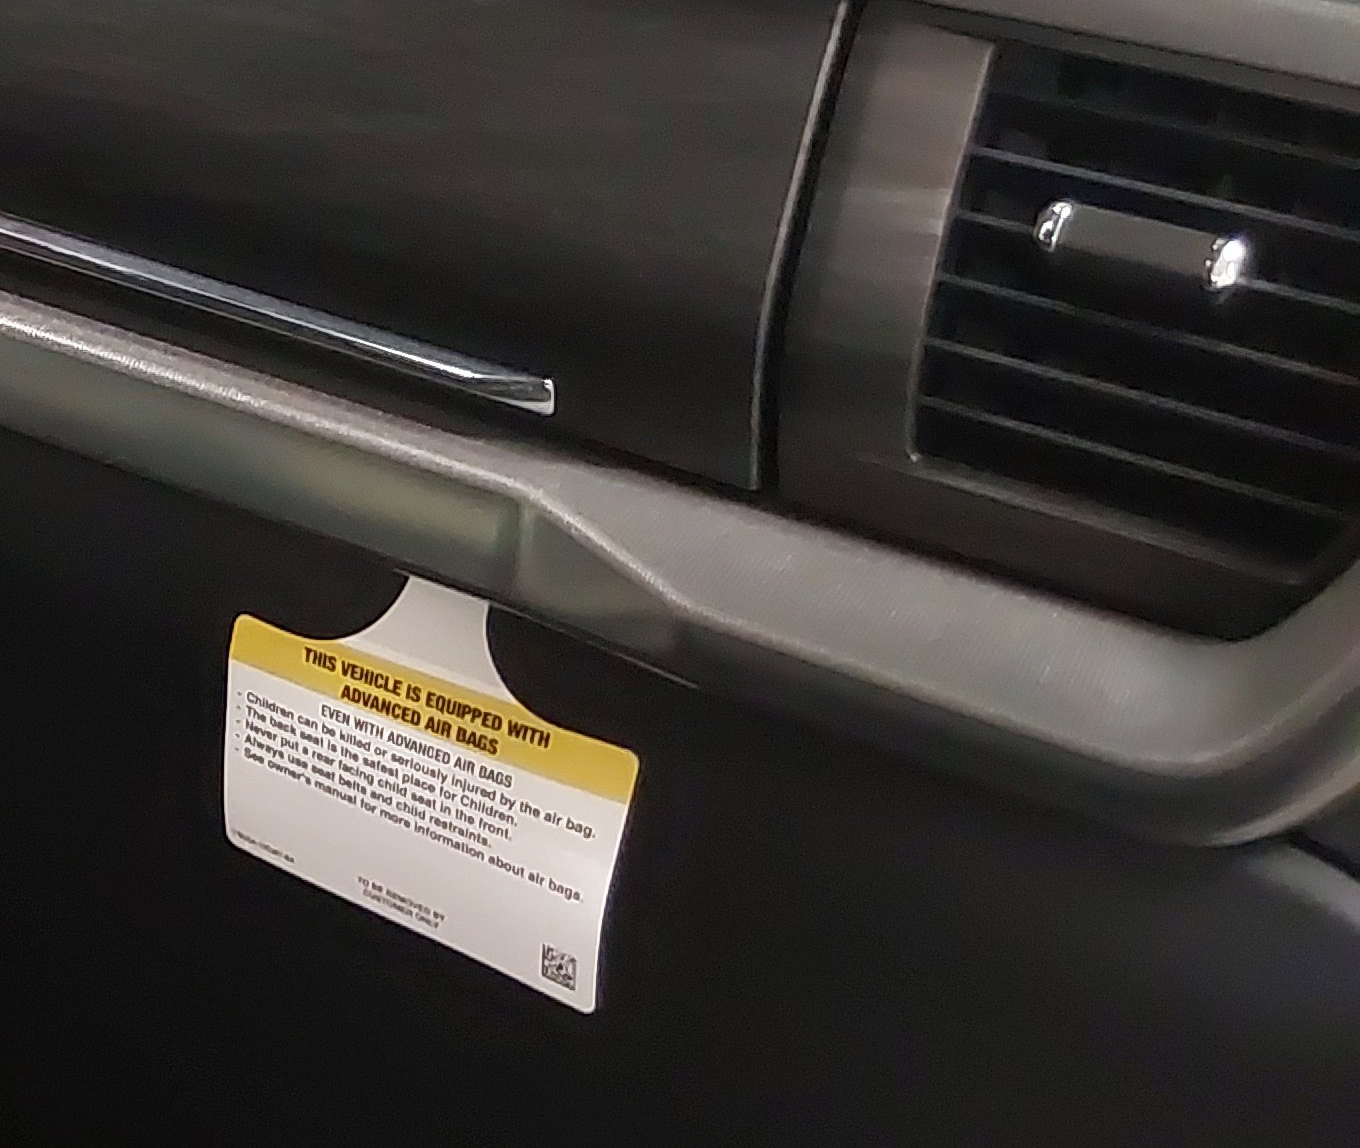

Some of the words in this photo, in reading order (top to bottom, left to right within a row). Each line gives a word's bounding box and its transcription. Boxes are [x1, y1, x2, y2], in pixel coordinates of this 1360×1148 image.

[304, 646, 337, 673] THIS
[341, 660, 403, 697] VEHICLE
[406, 684, 421, 703] IS
[425, 691, 502, 731] EQUIPPED
[508, 719, 551, 749] WITH
[321, 704, 350, 726] EVEN
[354, 716, 384, 739] WITH
[387, 730, 451, 765] ADVANCED
[454, 756, 476, 775] AIR
[479, 765, 513, 788] BAGS
[340, 685, 421, 726] ADVANCED
[424, 716, 452, 738] AIR
[455, 725, 499, 755] BAGS
[244, 733, 284, 760] Always
[287, 754, 309, 770] use
[311, 764, 336, 782] seat
[338, 773, 367, 796] belts
[370, 789, 393, 806] and
[396, 801, 426, 821] child
[245, 719, 278, 742] Never
[280, 736, 299, 752] put
[302, 746, 309, 755] a
[312, 750, 336, 767] rear
[339, 759, 374, 786] facing
[378, 776, 408, 797] child
[411, 792, 437, 812] seat
[440, 803, 452, 817] in
[455, 808, 475, 825] the
[246, 705, 267, 723] The
[270, 713, 297, 736] back
[300, 730, 324, 748] seat
[327, 739, 338, 753] is
[341, 745, 359, 763] the
[363, 756, 399, 779] safest
[402, 771, 436, 794] place
[439, 786, 458, 801] for
[246, 691, 295, 720] Children
[297, 715, 319, 730] can
[321, 723, 336, 737] be
[340, 729, 371, 752] killed
[374, 746, 386, 758] or
[391, 753, 448, 785] seriously
[451, 773, 496, 802] injured
[500, 792, 517, 811] by
[519, 801, 541, 819] the
[544, 811, 563, 826] air
[566, 817, 596, 839] bag.
[243, 747, 265, 765] See
[267, 758, 311, 786] owner's
[314, 780, 357, 805] manual
[360, 797, 377, 813] for
[380, 809, 411, 829] more
[414, 822, 485, 862] information
[488, 855, 525, 878] about
[527, 871, 545, 887] air
